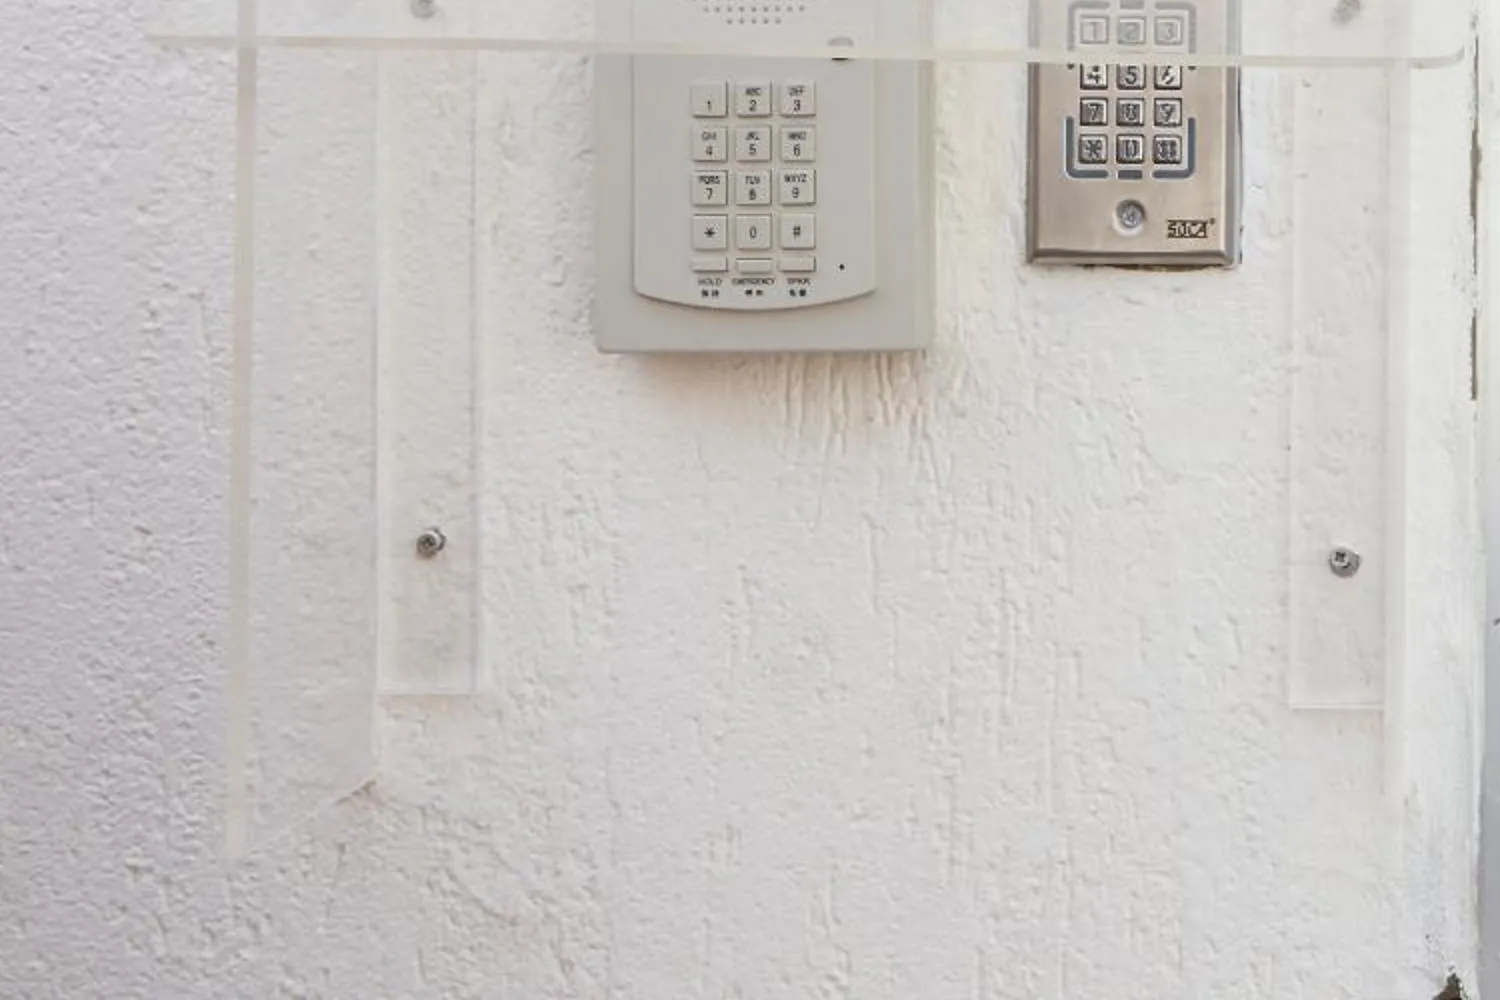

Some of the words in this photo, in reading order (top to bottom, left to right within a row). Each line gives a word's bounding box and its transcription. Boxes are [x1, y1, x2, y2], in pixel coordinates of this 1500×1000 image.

[1125, 22, 1137, 41] 2
[1164, 22, 1175, 41] 3
[1087, 66, 1101, 84] 4
[1126, 65, 1137, 85] 5
[749, 99, 757, 112] 2
[793, 99, 801, 112] 3
[1088, 103, 1099, 121] 7
[1125, 103, 1137, 121] 8
[1161, 103, 1175, 122] 9
[705, 145, 713, 156] 4
[748, 144, 757, 156] 5
[793, 144, 801, 157] 6
[1126, 139, 1138, 157] 0
[705, 187, 713, 200] 7
[748, 188, 757, 201] 8
[791, 186, 800, 199] 9
[749, 225, 758, 240] 0
